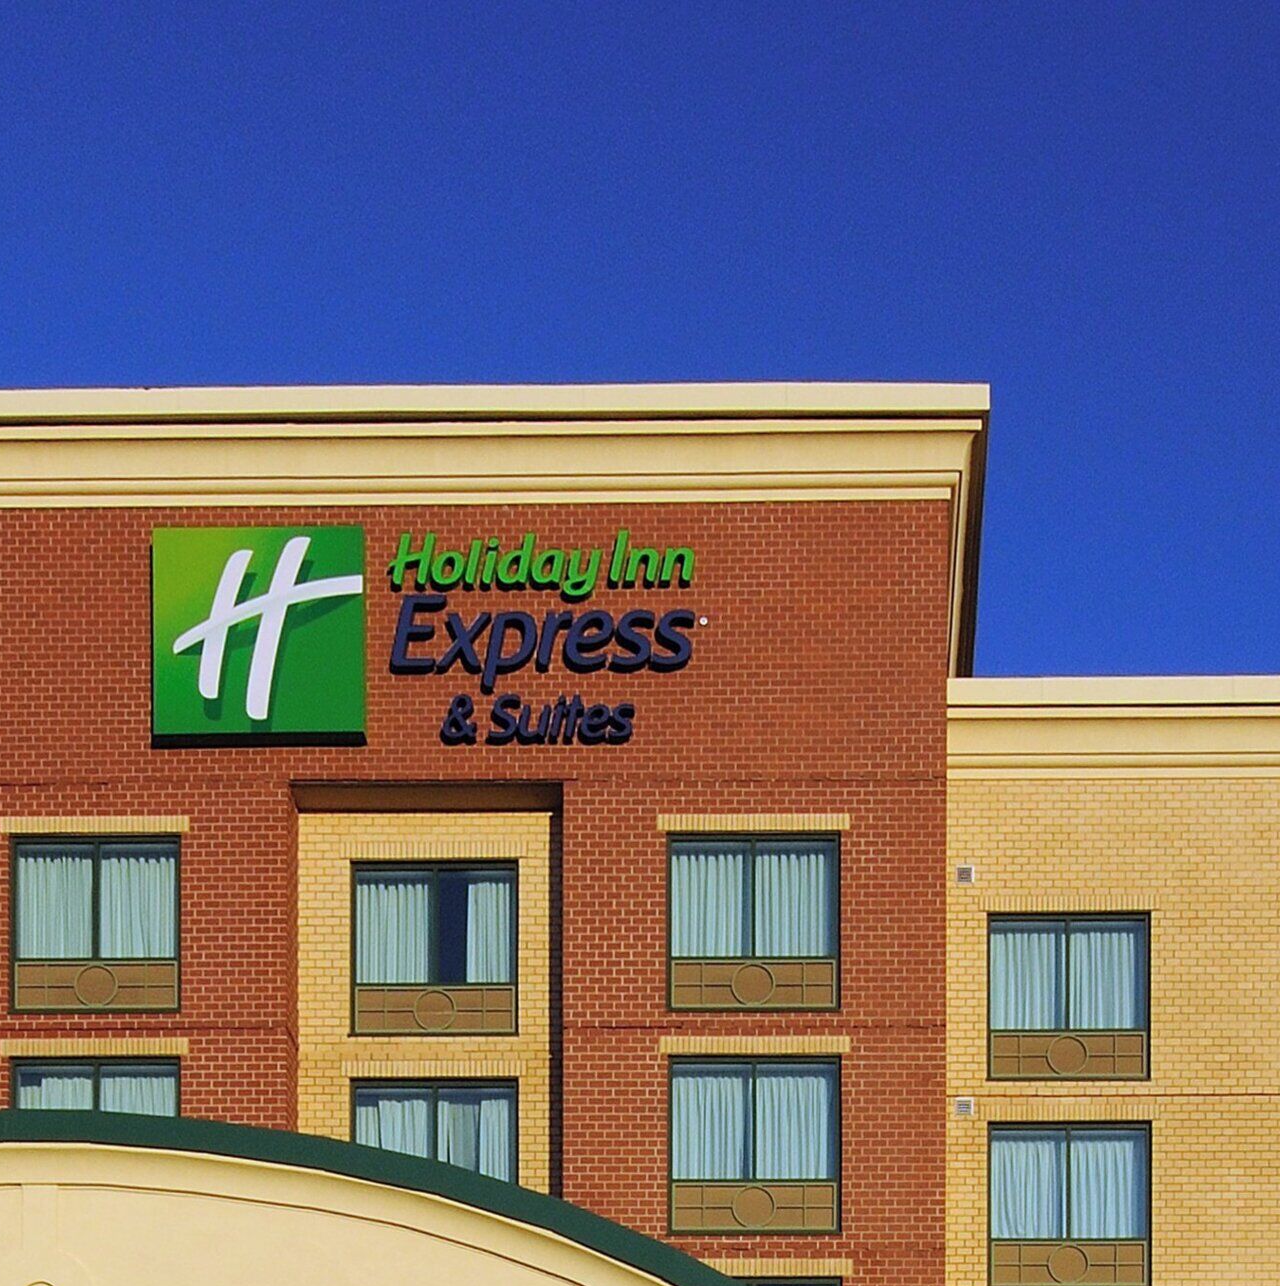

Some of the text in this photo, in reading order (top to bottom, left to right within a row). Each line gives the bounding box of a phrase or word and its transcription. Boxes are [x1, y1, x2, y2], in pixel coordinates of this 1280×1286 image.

[388, 530, 694, 597] Holiday Inn
[390, 594, 695, 690] Express
[442, 694, 633, 740] & Suites
